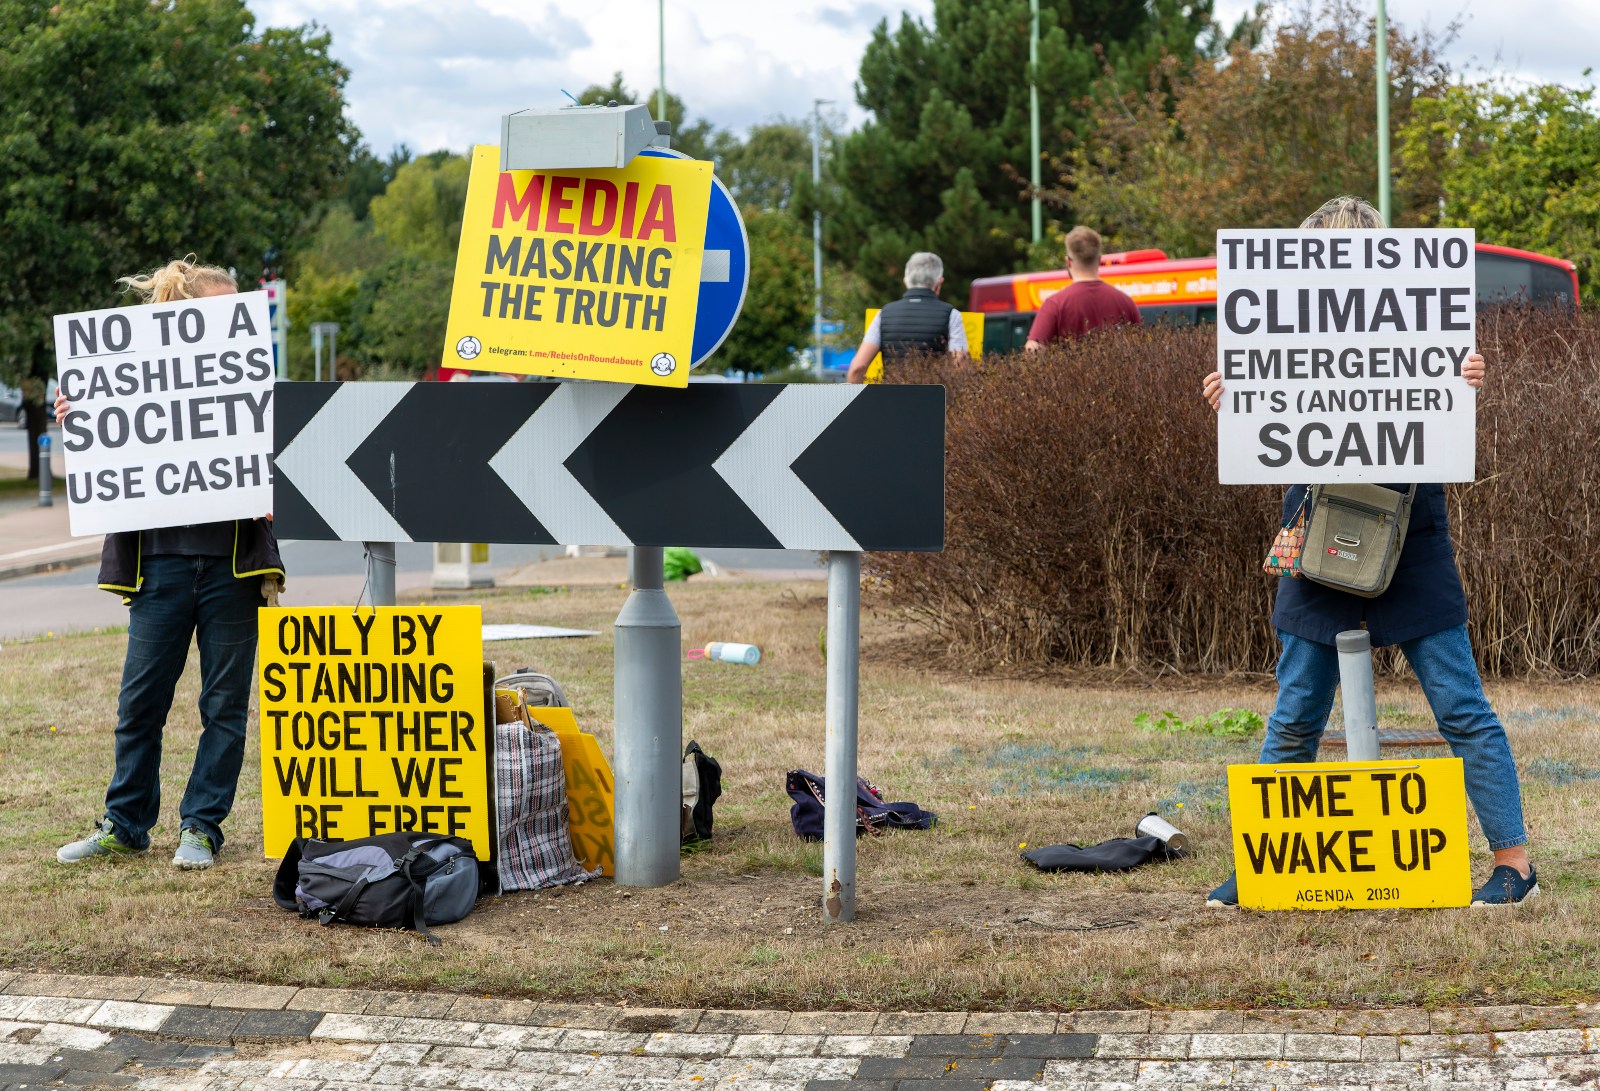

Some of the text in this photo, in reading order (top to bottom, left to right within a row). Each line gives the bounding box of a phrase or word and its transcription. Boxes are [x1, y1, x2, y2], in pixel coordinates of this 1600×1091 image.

[491, 173, 677, 243] MEDIA
[482, 235, 672, 290] MASKING
[1222, 238, 1468, 269] THERE IS NO
[481, 282, 668, 331] THE TRUTH
[1225, 288, 1470, 334] CLIMATE
[68, 303, 257, 356] NO TO A
[60, 348, 271, 402] CASHLESS
[488, 346, 643, 367] telegram: t.me/RebelsOnRoundabouts
[1224, 347, 1470, 380] EMERGENCY
[63, 390, 273, 453] SOCIETY
[1234, 389, 1453, 413] IT'S (ANOTHER)
[1258, 422, 1424, 467] SCAM
[66, 467, 145, 504] USE
[278, 614, 442, 656] ONLY BY
[264, 663, 453, 703] STANDING
[267, 711, 476, 751] TOGETHER
[273, 757, 463, 798] WILL WE
[1251, 773, 1426, 819] TIME TO
[294, 805, 344, 842] BE
[1242, 828, 1446, 874] WAKE UP
[1296, 888, 1399, 901] AGENDA 2030
